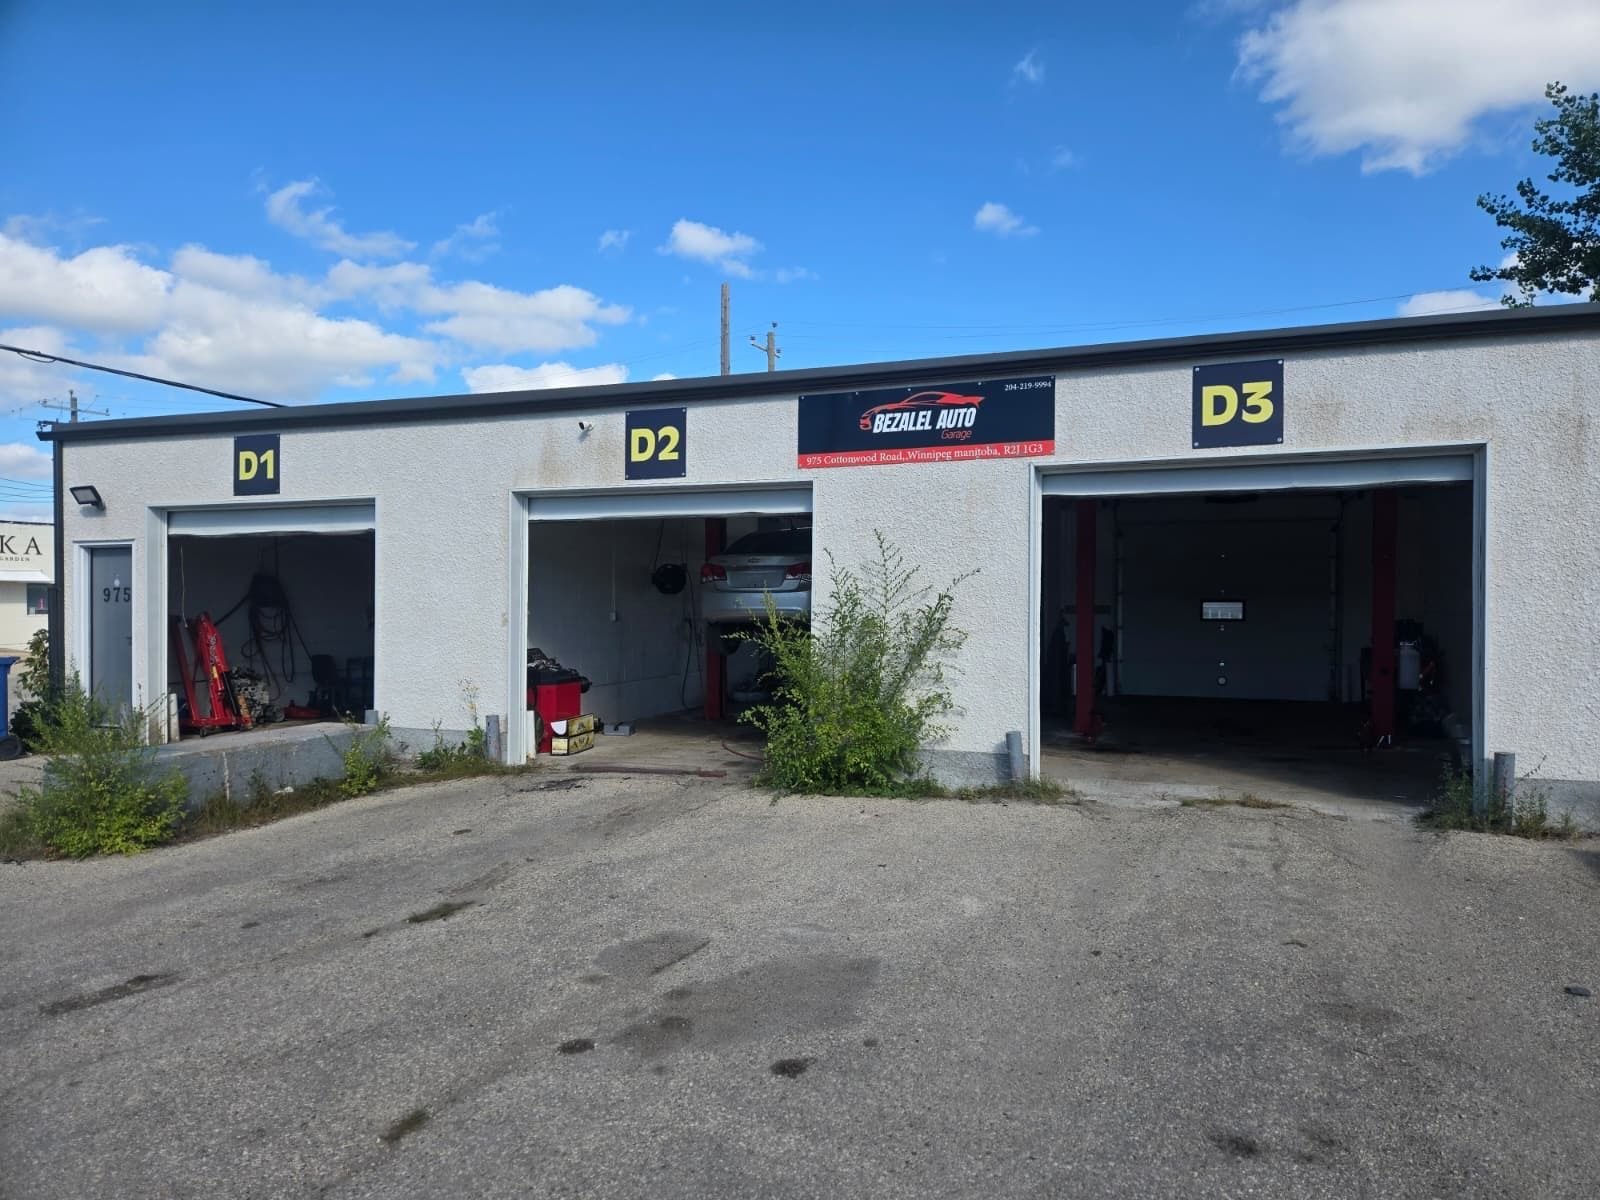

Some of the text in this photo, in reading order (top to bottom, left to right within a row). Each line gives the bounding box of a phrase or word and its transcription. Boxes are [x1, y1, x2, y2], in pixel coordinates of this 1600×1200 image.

[1202, 381, 1274, 427] D3
[872, 407, 977, 433] BEZALEL AUTO
[631, 425, 680, 462] D2
[941, 429, 972, 440] Garage
[239, 449, 274, 480] D1
[806, 456, 822, 466] 975
[824, 453, 877, 465] Cottonwood
[1004, 444, 1021, 456] R2J
[1024, 443, 1043, 454] 1G3
[103, 587, 132, 602] 975
